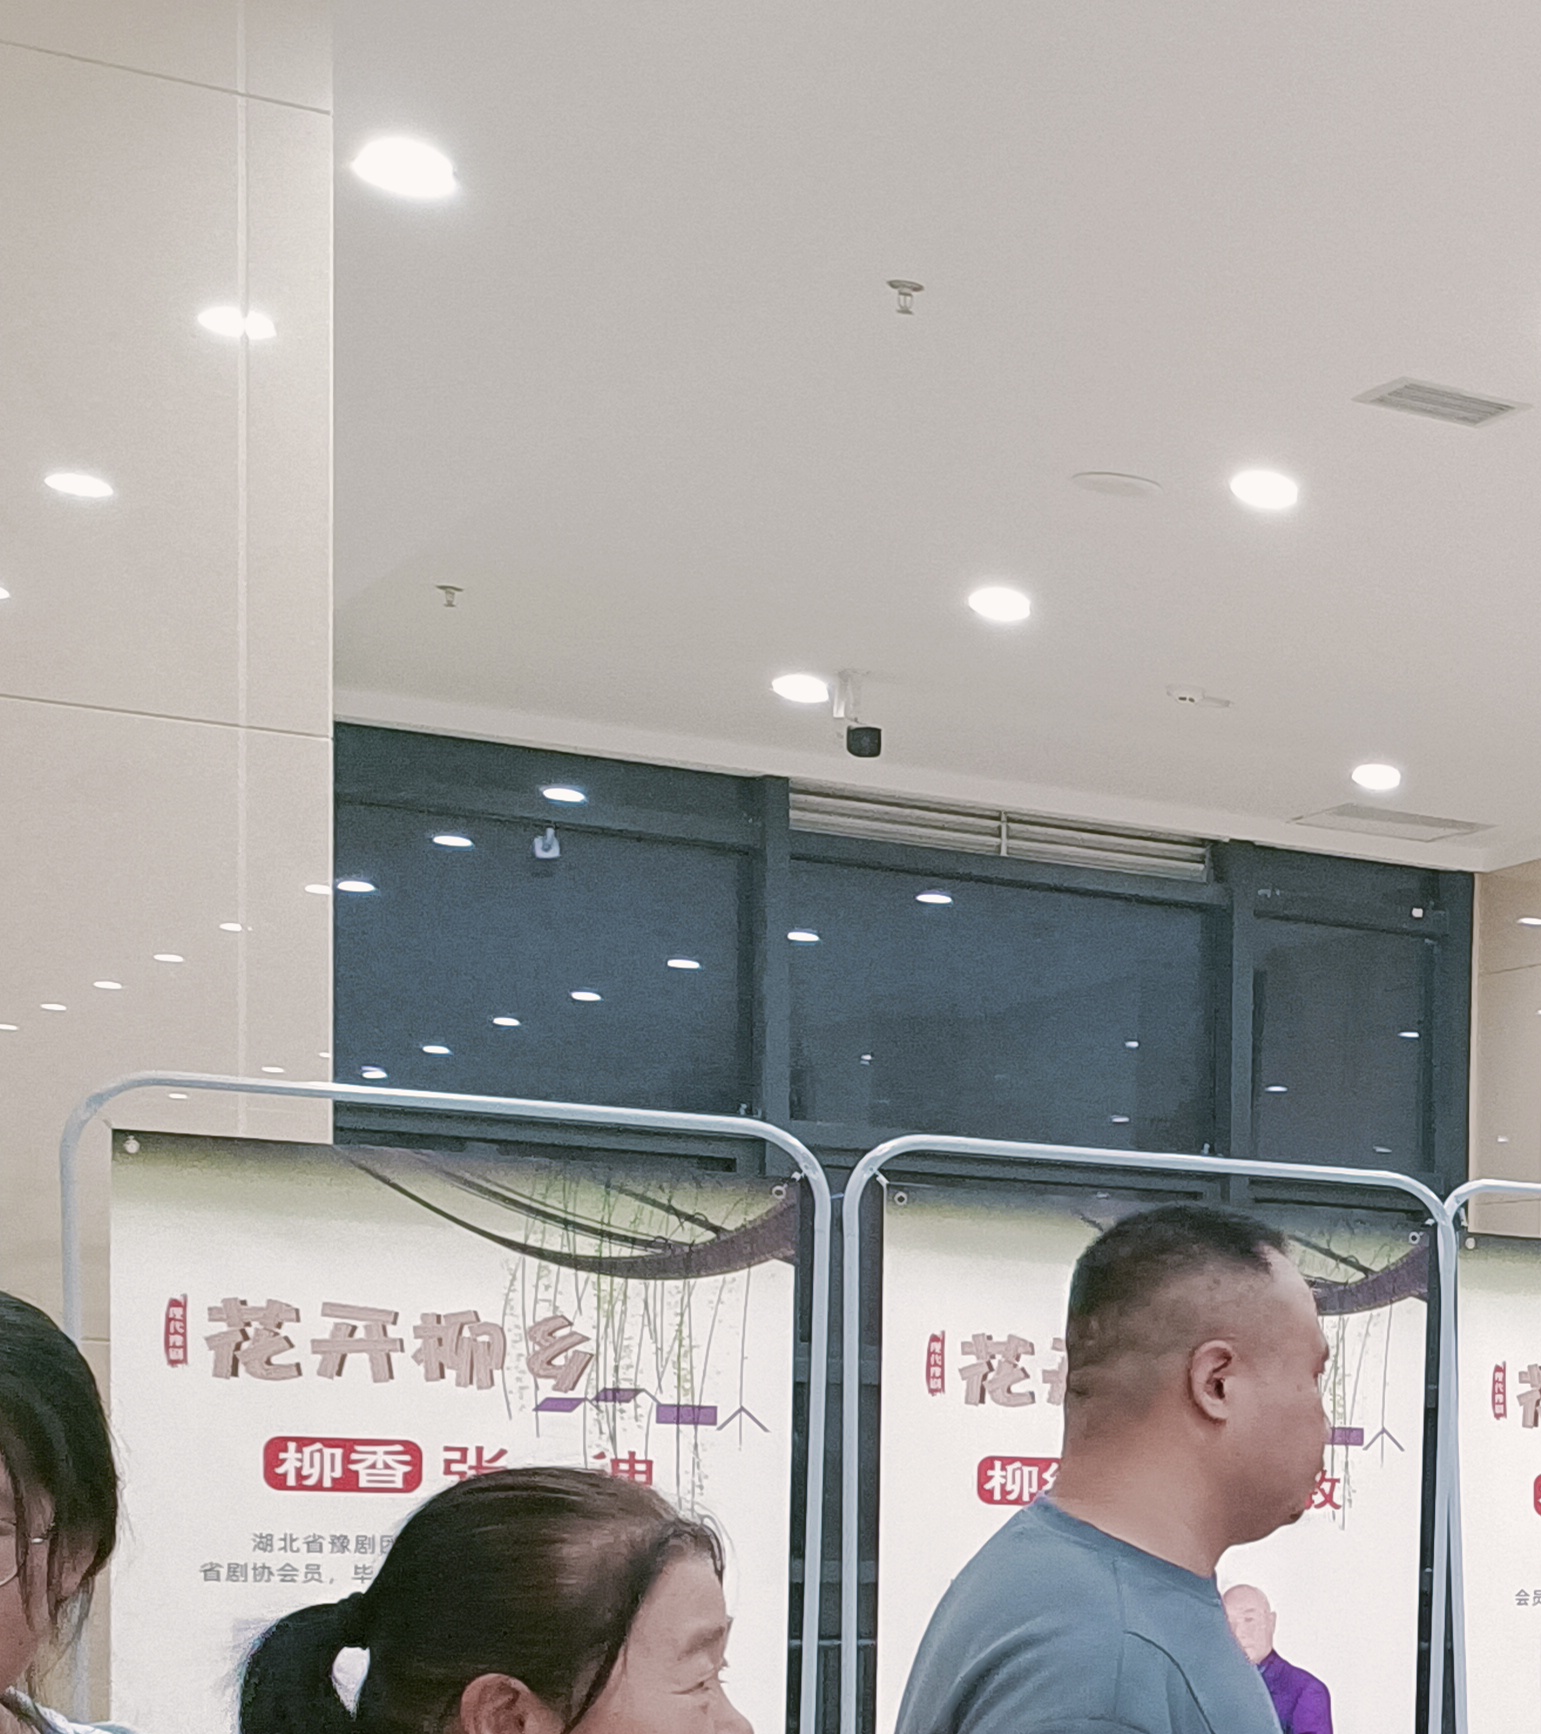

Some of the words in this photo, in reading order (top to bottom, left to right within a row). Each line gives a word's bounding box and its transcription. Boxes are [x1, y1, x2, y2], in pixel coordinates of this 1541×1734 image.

[204, 1297, 595, 1394] 花开柳乡
[273, 1440, 413, 1488] 柳香
